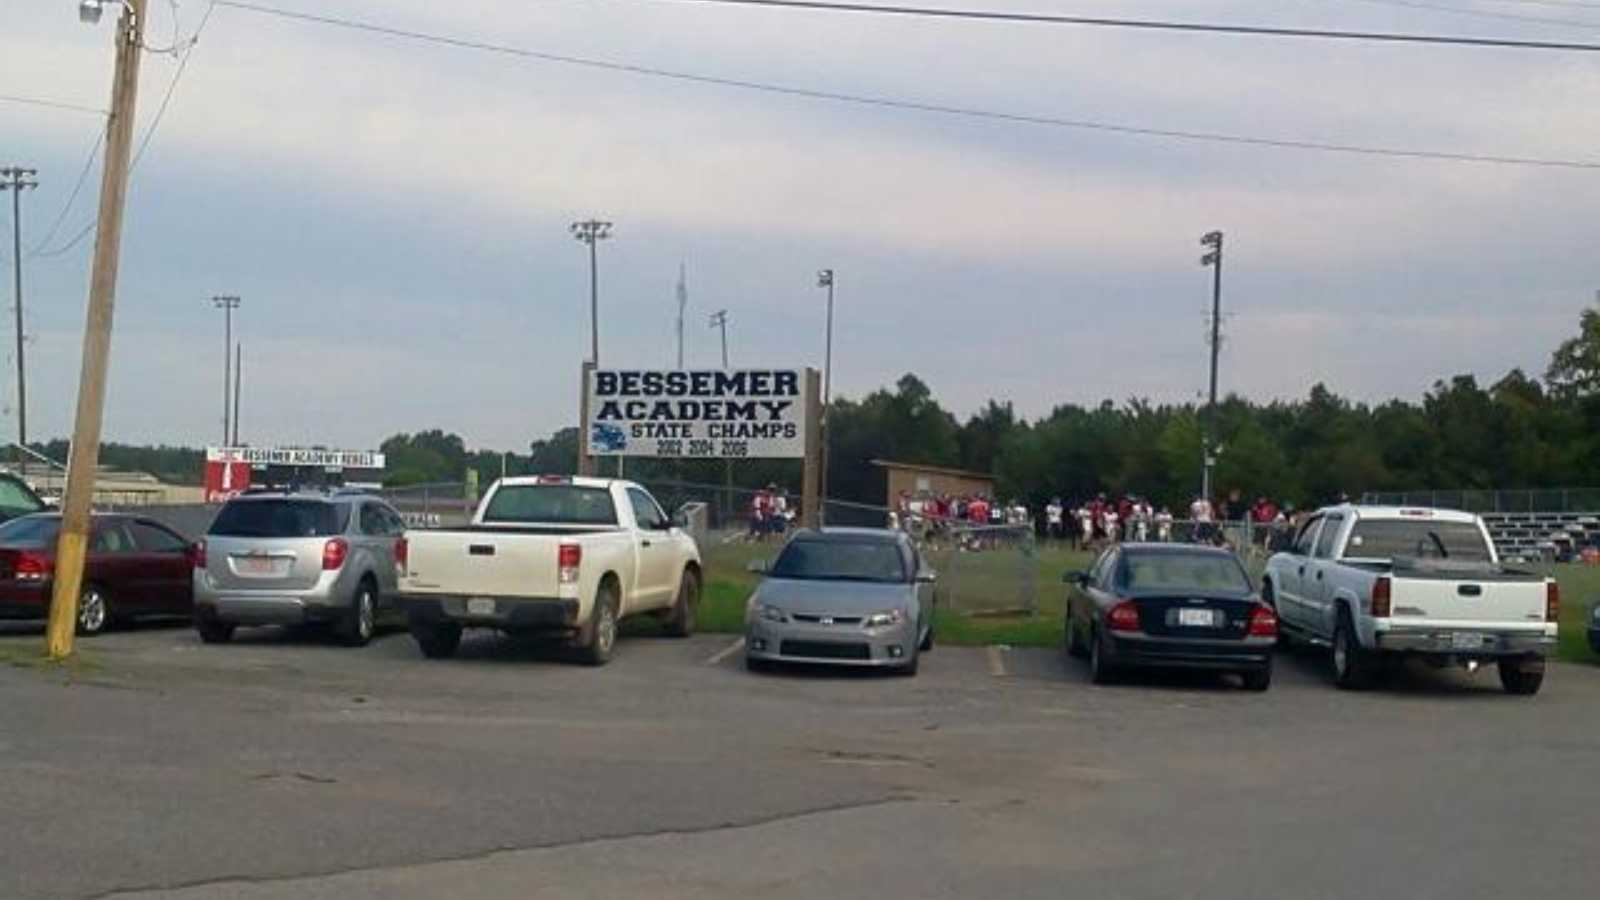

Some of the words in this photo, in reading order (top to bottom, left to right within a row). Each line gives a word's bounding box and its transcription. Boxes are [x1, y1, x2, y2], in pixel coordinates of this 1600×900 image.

[596, 371, 798, 396] BESSEMER
[597, 400, 793, 420] ACADEMY
[631, 422, 693, 438] STATE
[708, 422, 797, 438] CHAMPS
[295, 450, 339, 464] ACADEMY
